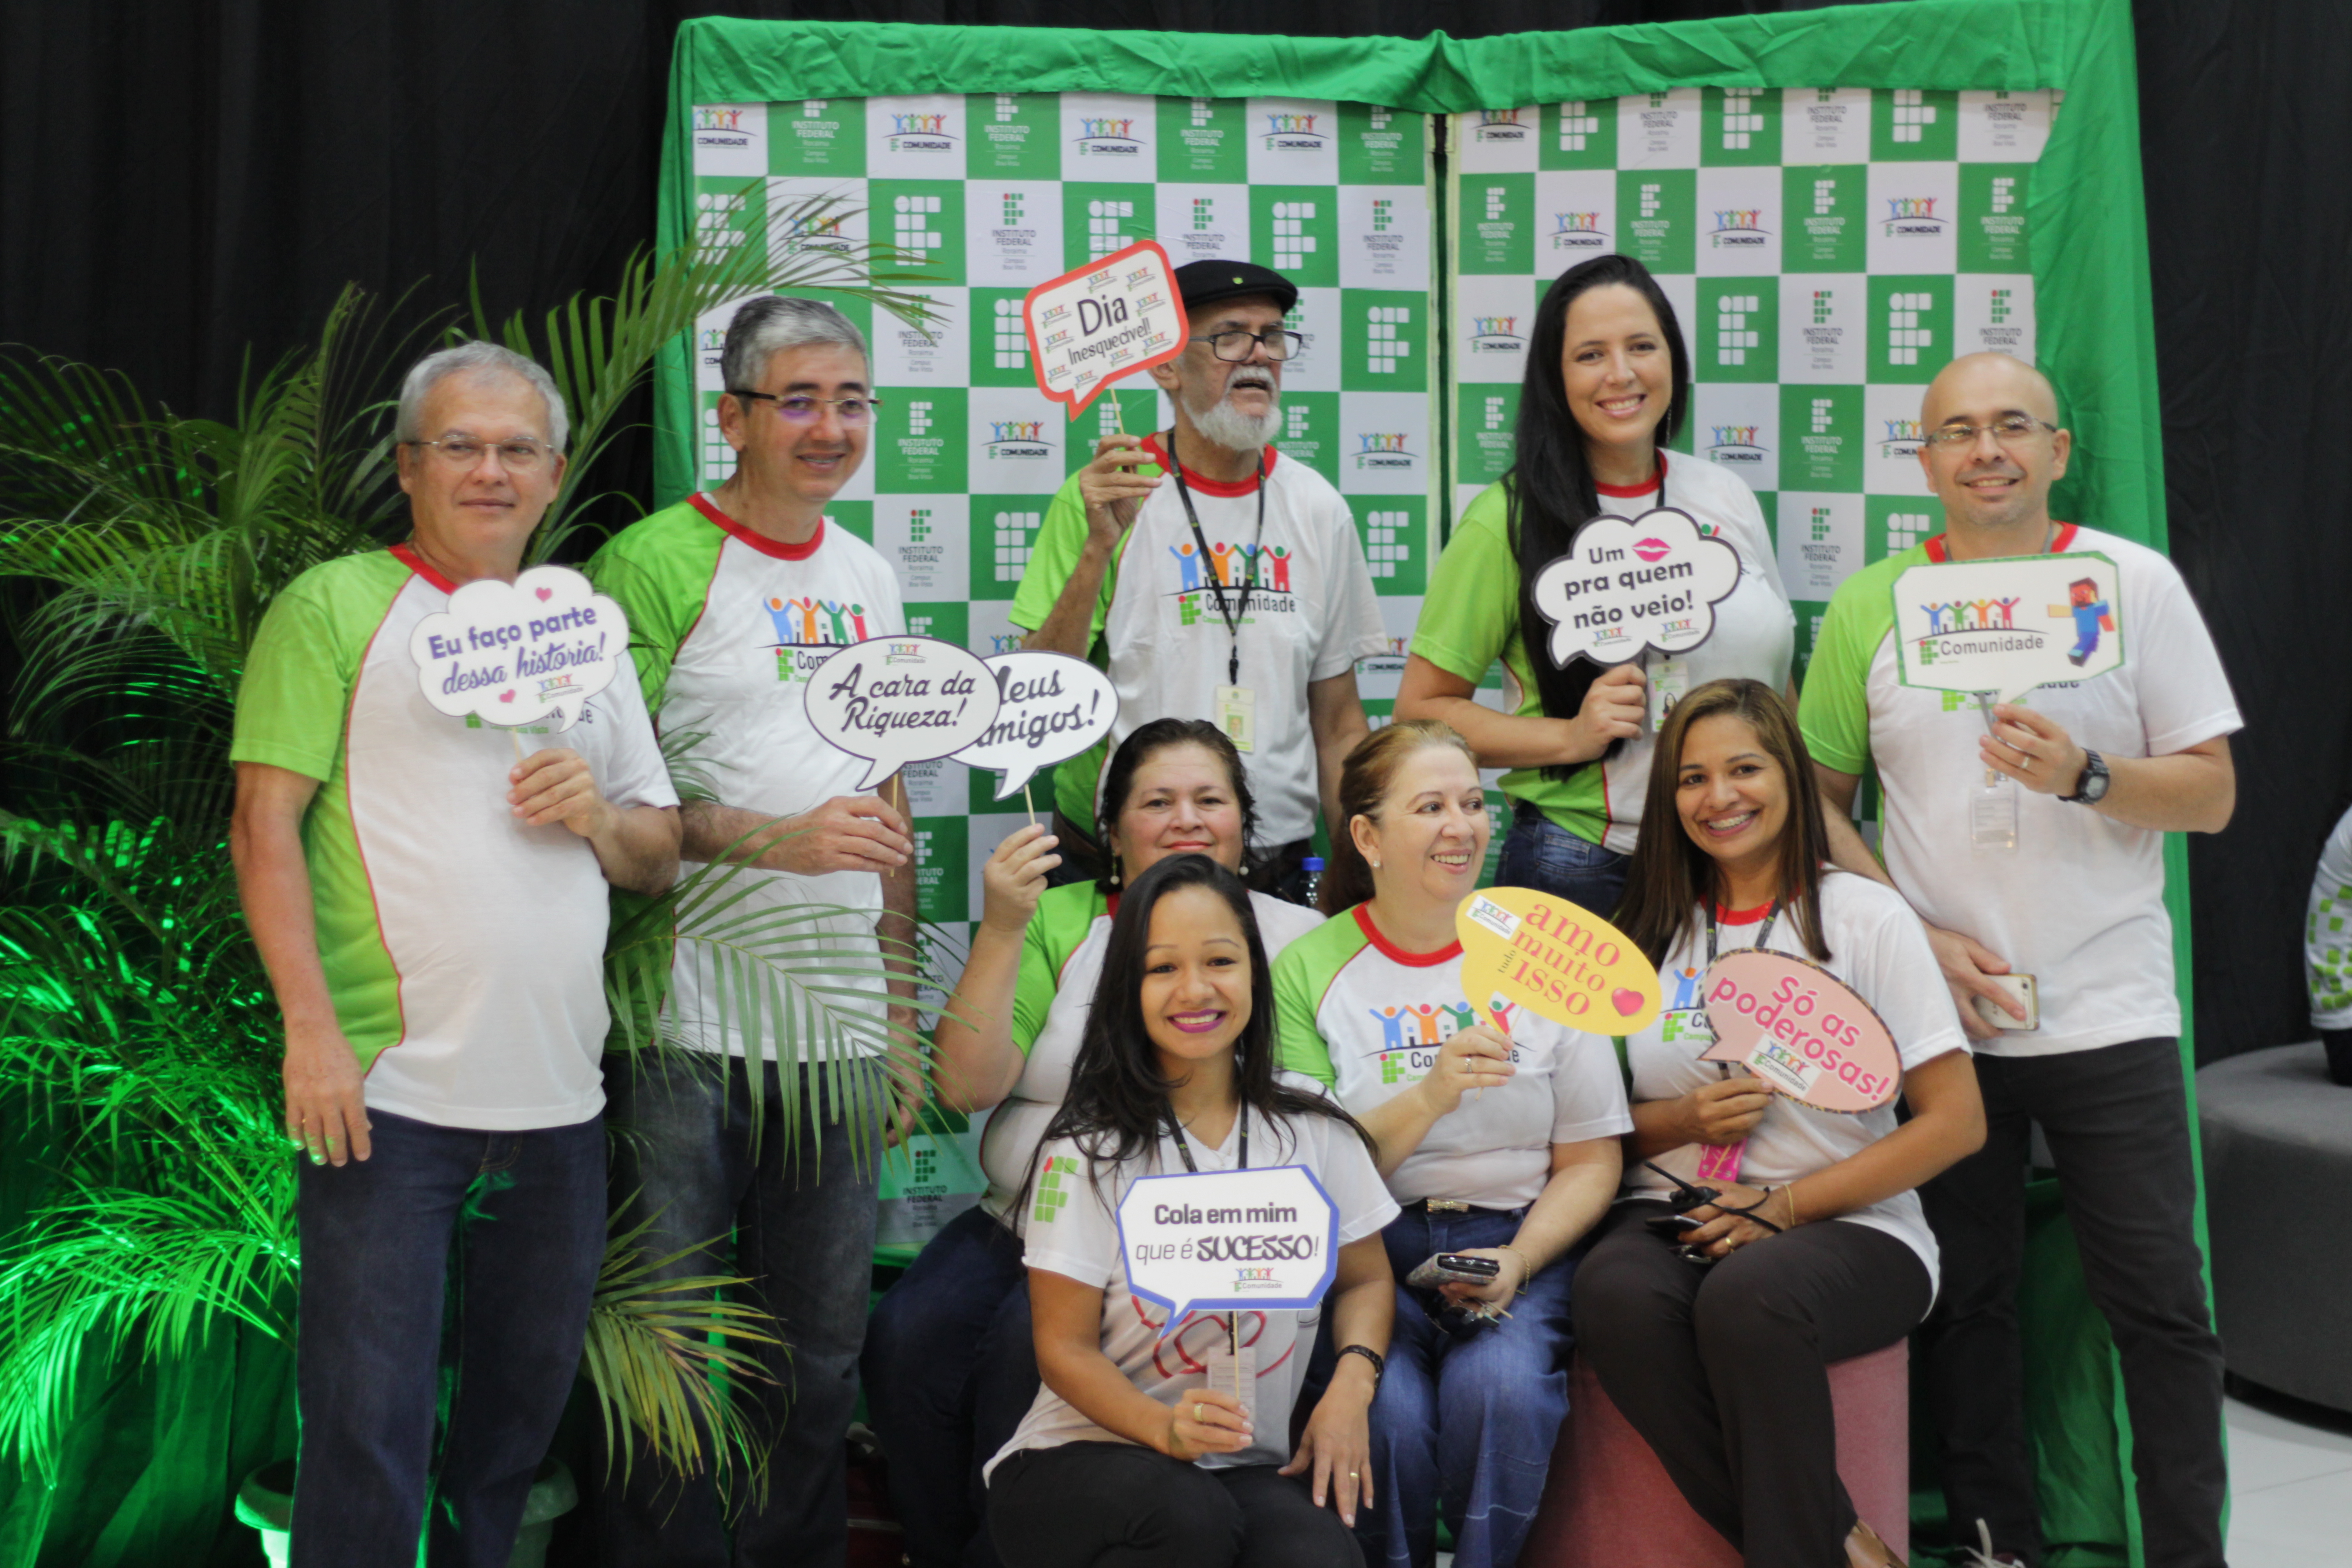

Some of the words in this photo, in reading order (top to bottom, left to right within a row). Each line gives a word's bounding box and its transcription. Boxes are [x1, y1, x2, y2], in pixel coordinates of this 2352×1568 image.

[1985, 103, 2027, 112] INSTITUTO
[1640, 112, 1678, 120] INSTITUTO
[1988, 112, 2022, 120] FEDERAL
[793, 121, 839, 129] INSTITUTO
[985, 125, 1029, 134] INSTITUTO
[797, 130, 835, 138] FEDERAL
[989, 134, 1025, 142] FEDERAL
[1181, 130, 1224, 138] INSTITUTO
[1361, 132, 1402, 141] INSTITUTO
[697, 137, 749, 146] COMUNIDADE
[1184, 138, 1220, 146] FEDERAL
[1364, 141, 1399, 149] FEDERAL
[1091, 145, 1139, 153] COMUNIDADE
[1896, 225, 1941, 234] COMUNIDADE
[1077, 294, 1129, 337] Dia
[1803, 328, 1842, 336] INSTITUTO
[1980, 328, 2022, 336] INSTITUTO
[1806, 336, 1839, 344] FEDERAL
[1983, 337, 2018, 345] FEDERAL
[898, 438, 943, 446] INSTITUTO
[902, 447, 939, 455] FEDERAL
[1801, 545, 1841, 554] INSTITUTO
[902, 554, 939, 563] FEDERAL
[1589, 547, 1624, 564] Um
[1804, 554, 1837, 562] FEDERAL
[1564, 576, 1609, 601] pra
[1618, 562, 1693, 590] quem
[1573, 605, 1622, 629] não
[1631, 589, 1694, 618] veio!
[428, 635, 463, 659] Eu
[468, 626, 522, 650] faço
[529, 606, 597, 642] parte
[1941, 635, 2044, 655] Comunidade
[442, 661, 507, 695] dessa
[829, 663, 862, 700] A
[869, 674, 931, 698] cara
[941, 670, 976, 696] da
[841, 696, 967, 738] Riqueza!
[1480, 915, 1511, 936] Comunidade
[1525, 904, 1620, 966] amo
[1498, 950, 1516, 974] tudo
[1511, 930, 1605, 991] muito
[1772, 976, 1818, 1016] Só
[1821, 1014, 1861, 1047] as
[1708, 977, 1890, 1101] poderosas!
[1764, 1059, 1807, 1092] Comunidade
[1155, 1204, 1203, 1225] Cola
[1207, 1207, 1242, 1223] em
[1246, 1202, 1297, 1223] mim
[1136, 1243, 1175, 1265] que
[1181, 1238, 1193, 1259] é
